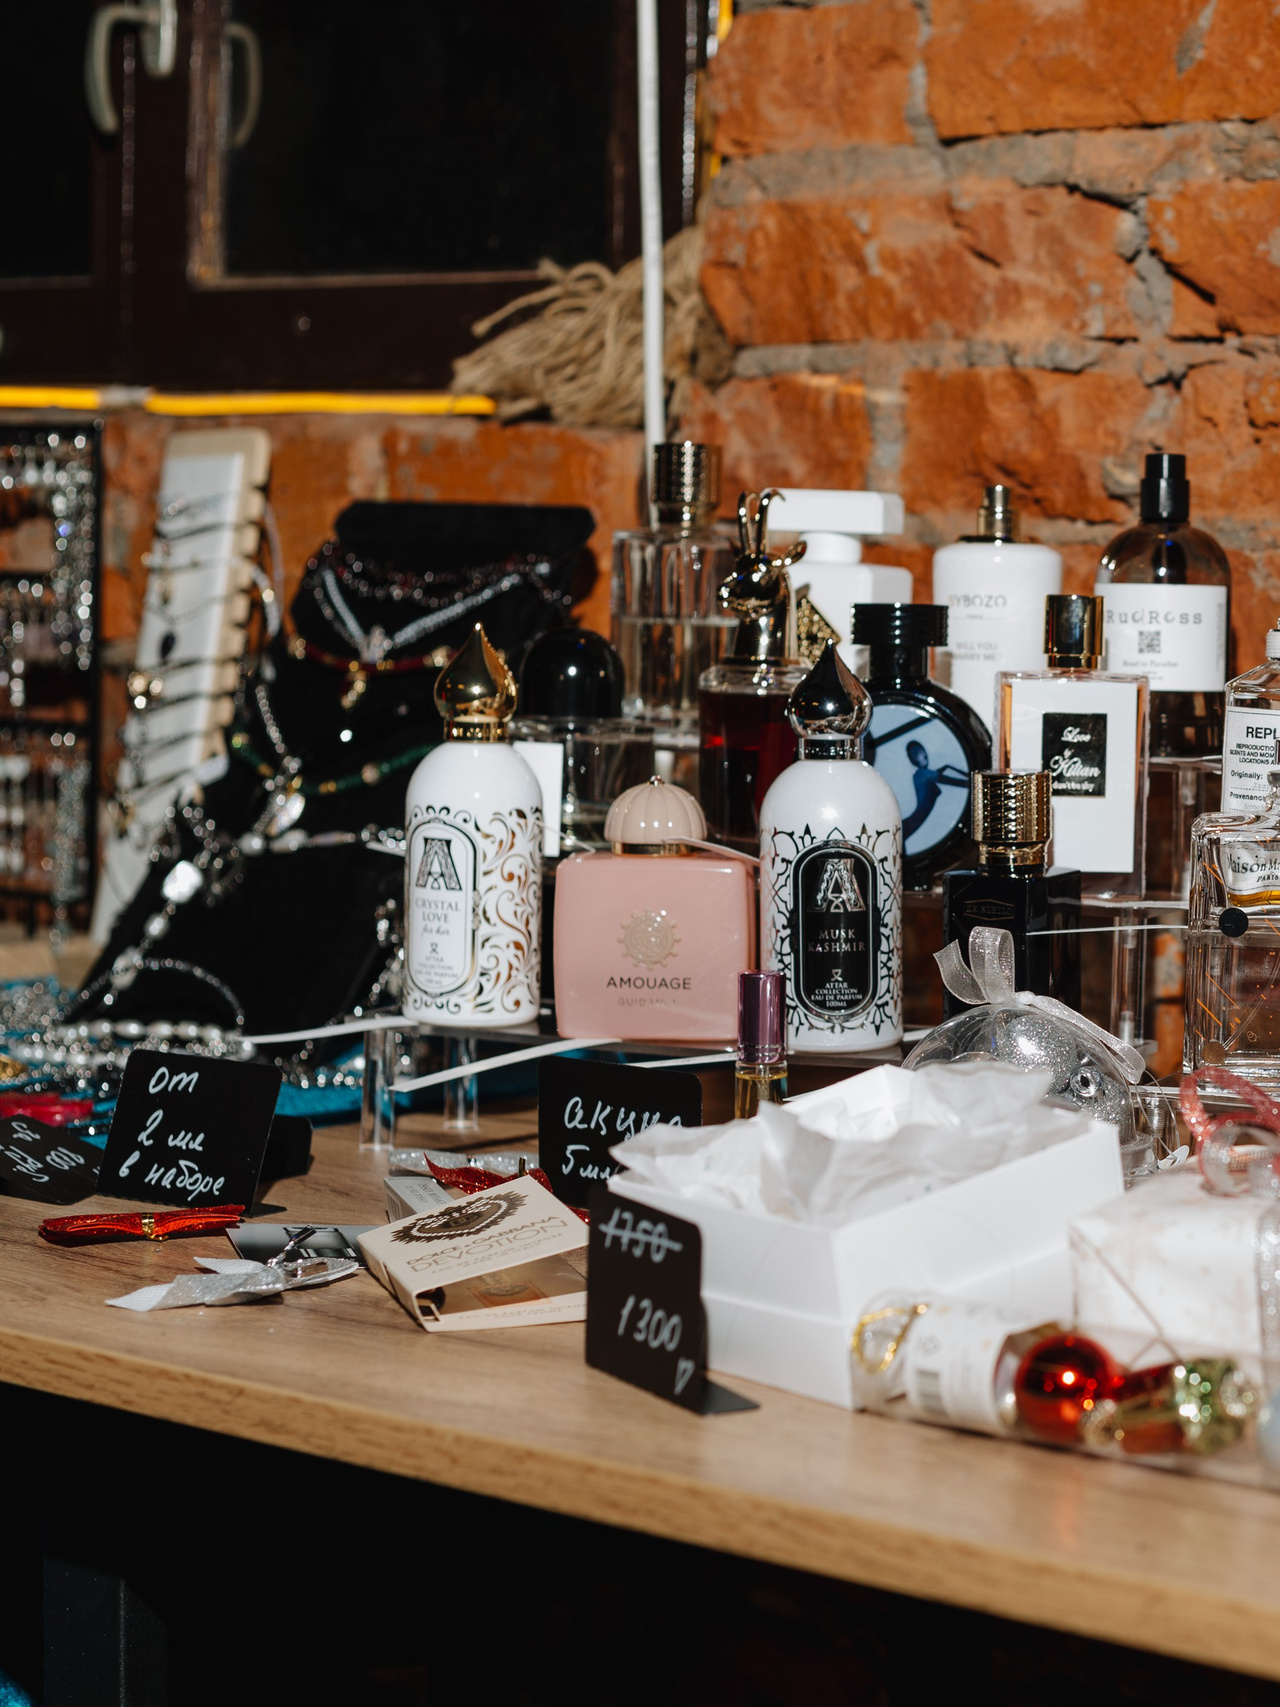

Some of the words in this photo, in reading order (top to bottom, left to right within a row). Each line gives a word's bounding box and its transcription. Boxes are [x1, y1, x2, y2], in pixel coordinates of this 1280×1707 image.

[1236, 743, 1274, 751] REPRODUCTIO
[414, 899, 461, 912] CRYSTAL
[422, 911, 449, 923] LOVE
[819, 929, 856, 939] MUSK
[808, 942, 866, 952] KASHMIR
[606, 976, 692, 991] AMOUAGE
[137, 1109, 163, 1146] 2
[562, 1144, 590, 1175] 5
[144, 1159, 225, 1201] наборе
[406, 1245, 460, 1266] DOLCE
[472, 1216, 559, 1245] GABBANA
[410, 1219, 568, 1273] DEVOTION
[617, 1295, 682, 1352] 1300
